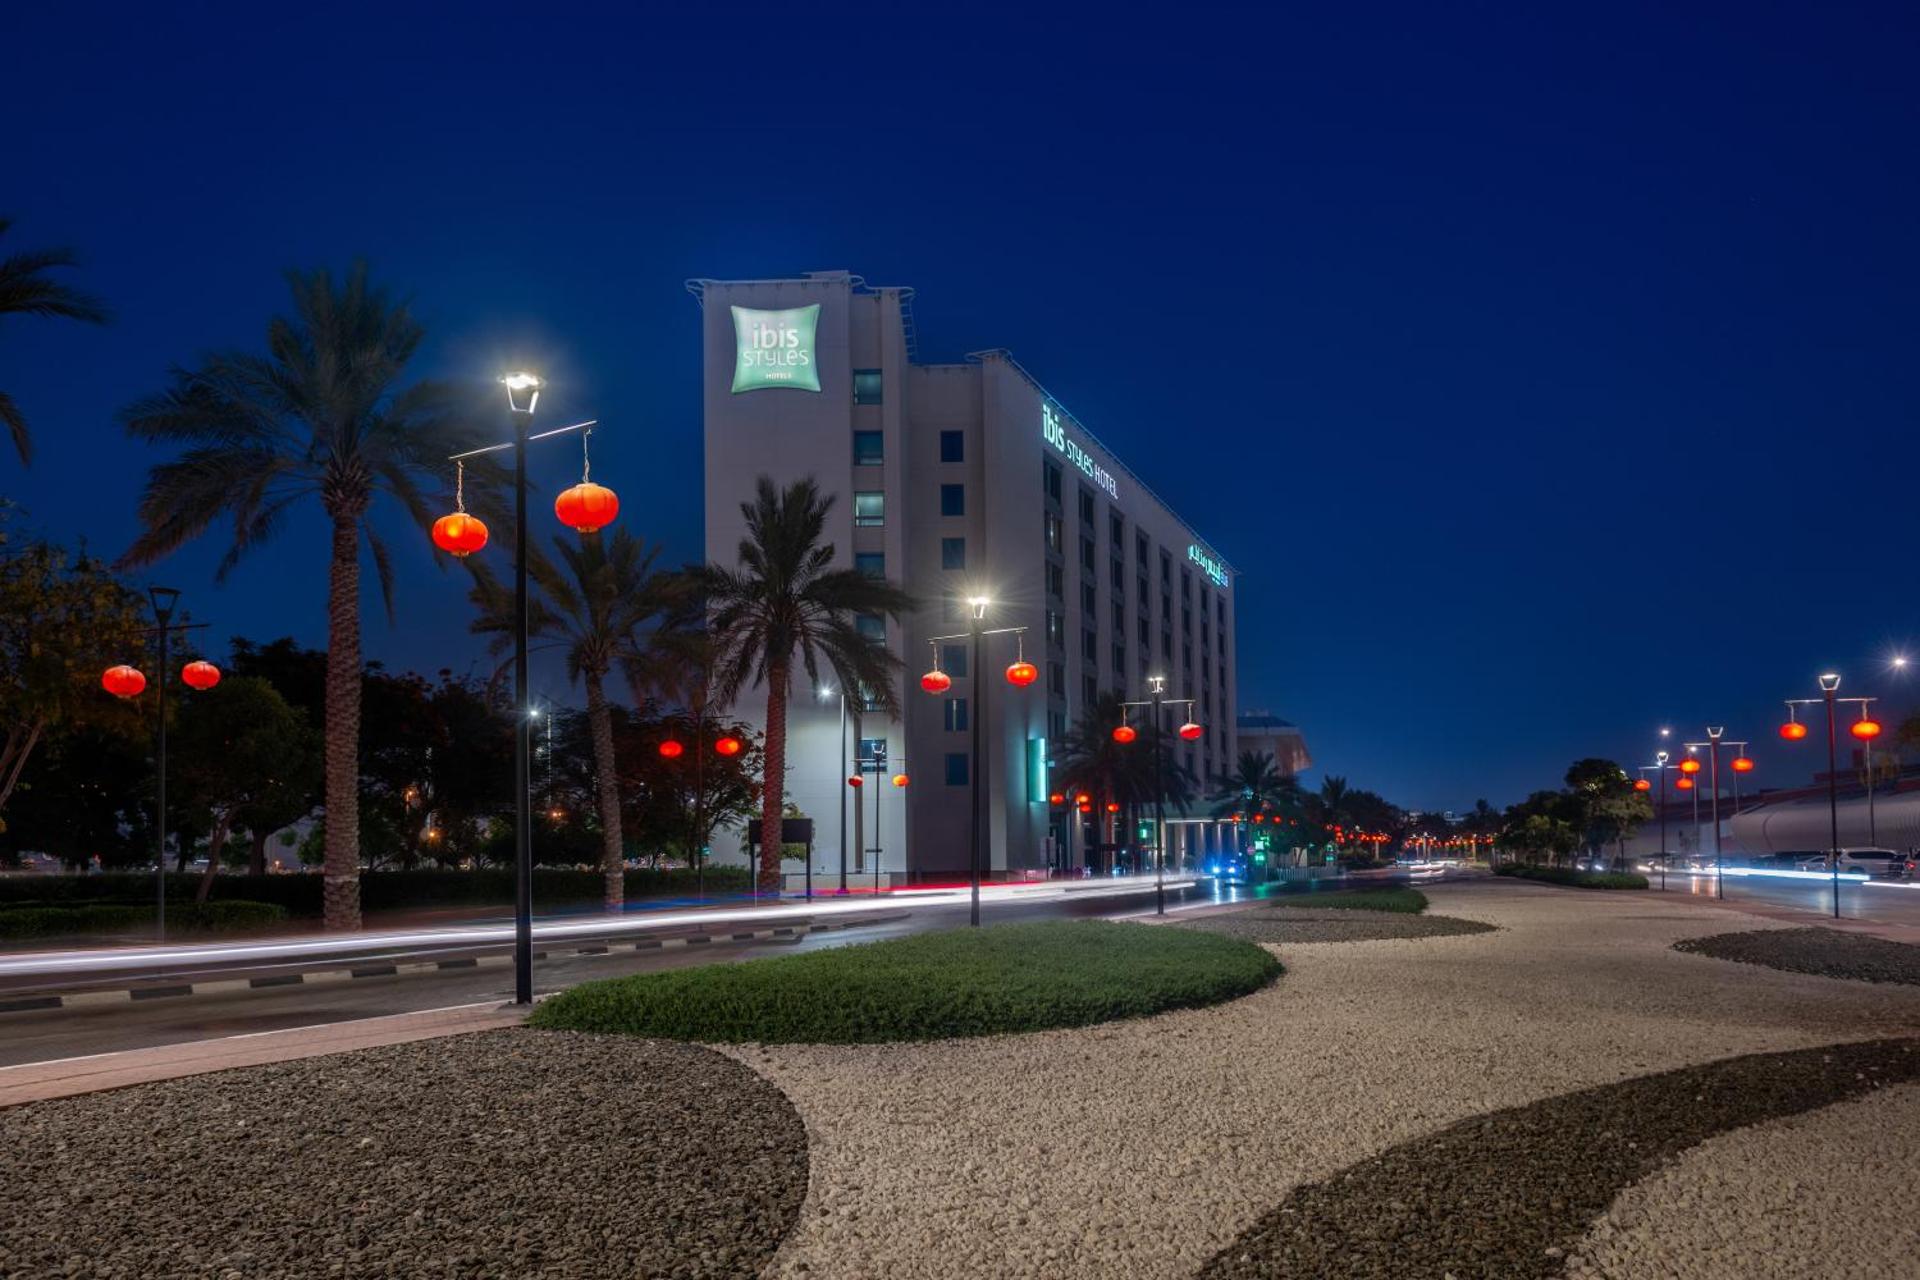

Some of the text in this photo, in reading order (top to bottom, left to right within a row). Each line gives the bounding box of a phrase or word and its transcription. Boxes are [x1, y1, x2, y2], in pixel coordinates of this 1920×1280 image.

[753, 322, 799, 348] ibis
[1043, 404, 1064, 452] ibis
[1095, 464, 1118, 499] HOTEL
